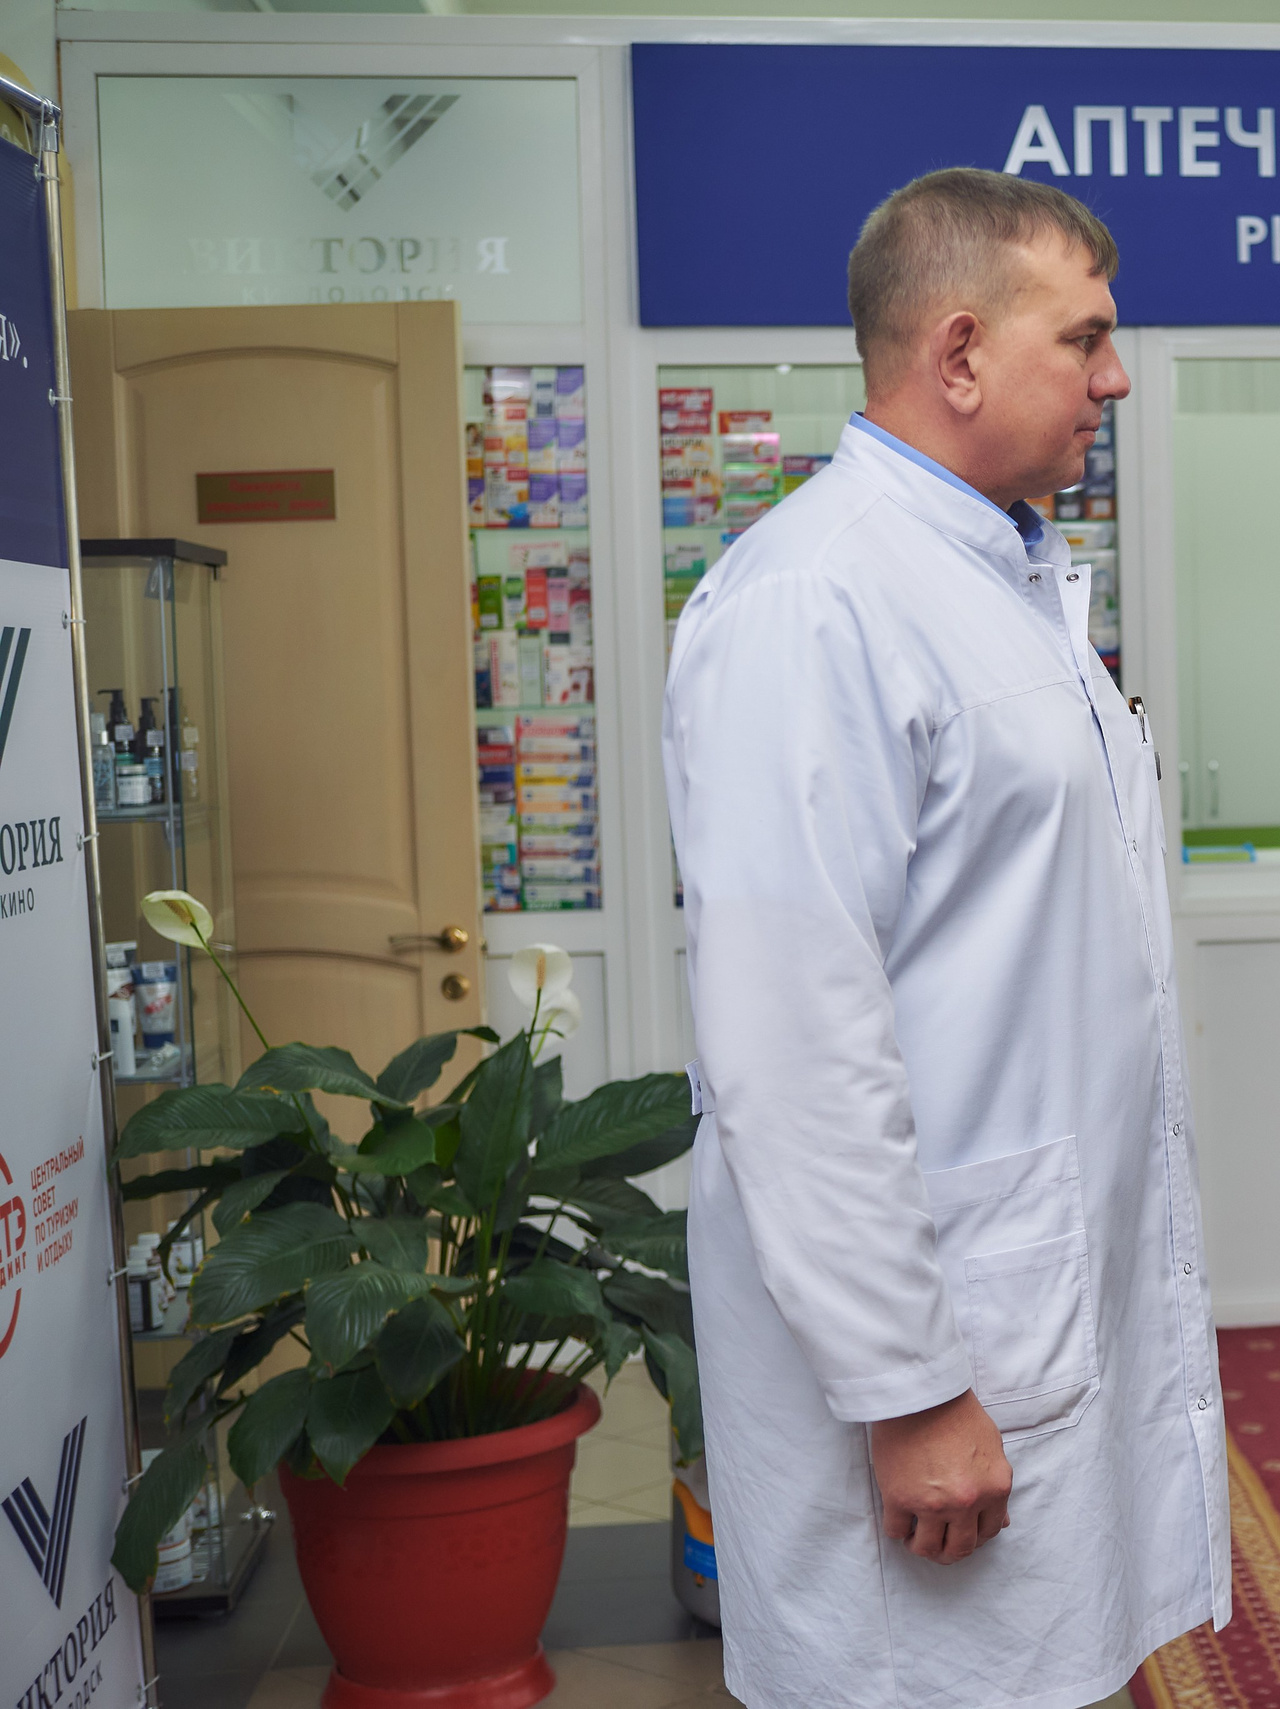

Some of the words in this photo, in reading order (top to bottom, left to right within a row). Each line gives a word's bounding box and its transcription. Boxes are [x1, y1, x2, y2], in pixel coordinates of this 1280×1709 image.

[30, 1135, 85, 1192] ЦЕНТРАЛЬНЫЙ
[32, 1185, 56, 1218] СОВЕТ
[34, 1221, 46, 1246] ПО
[46, 1197, 79, 1238] ТУРИЗМУ
[36, 1251, 44, 1274] И
[44, 1228, 74, 1267] ОТДЫХУ
[67, 1661, 103, 1709] ОДСК
